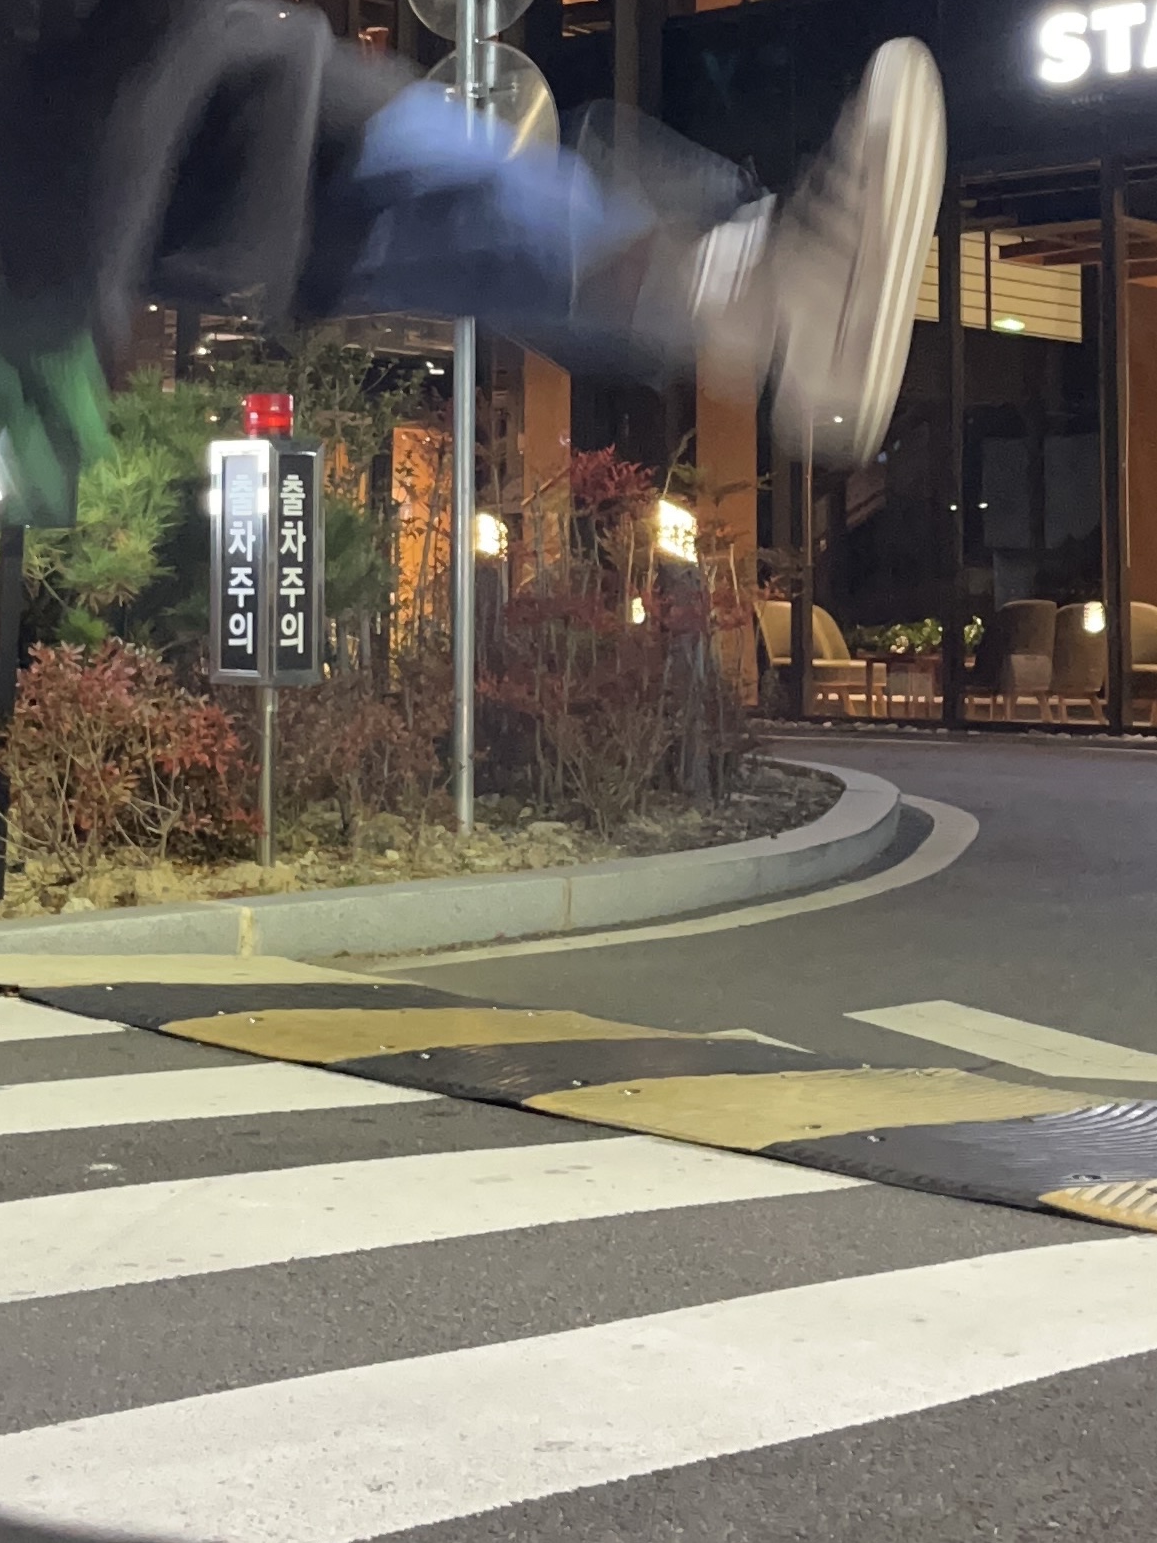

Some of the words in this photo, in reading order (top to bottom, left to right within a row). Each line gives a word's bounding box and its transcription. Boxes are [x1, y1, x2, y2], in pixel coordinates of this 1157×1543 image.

[1040, 2, 1157, 83] ST
[228, 474, 256, 655] 출차주의
[280, 474, 307, 654] 출차주의
